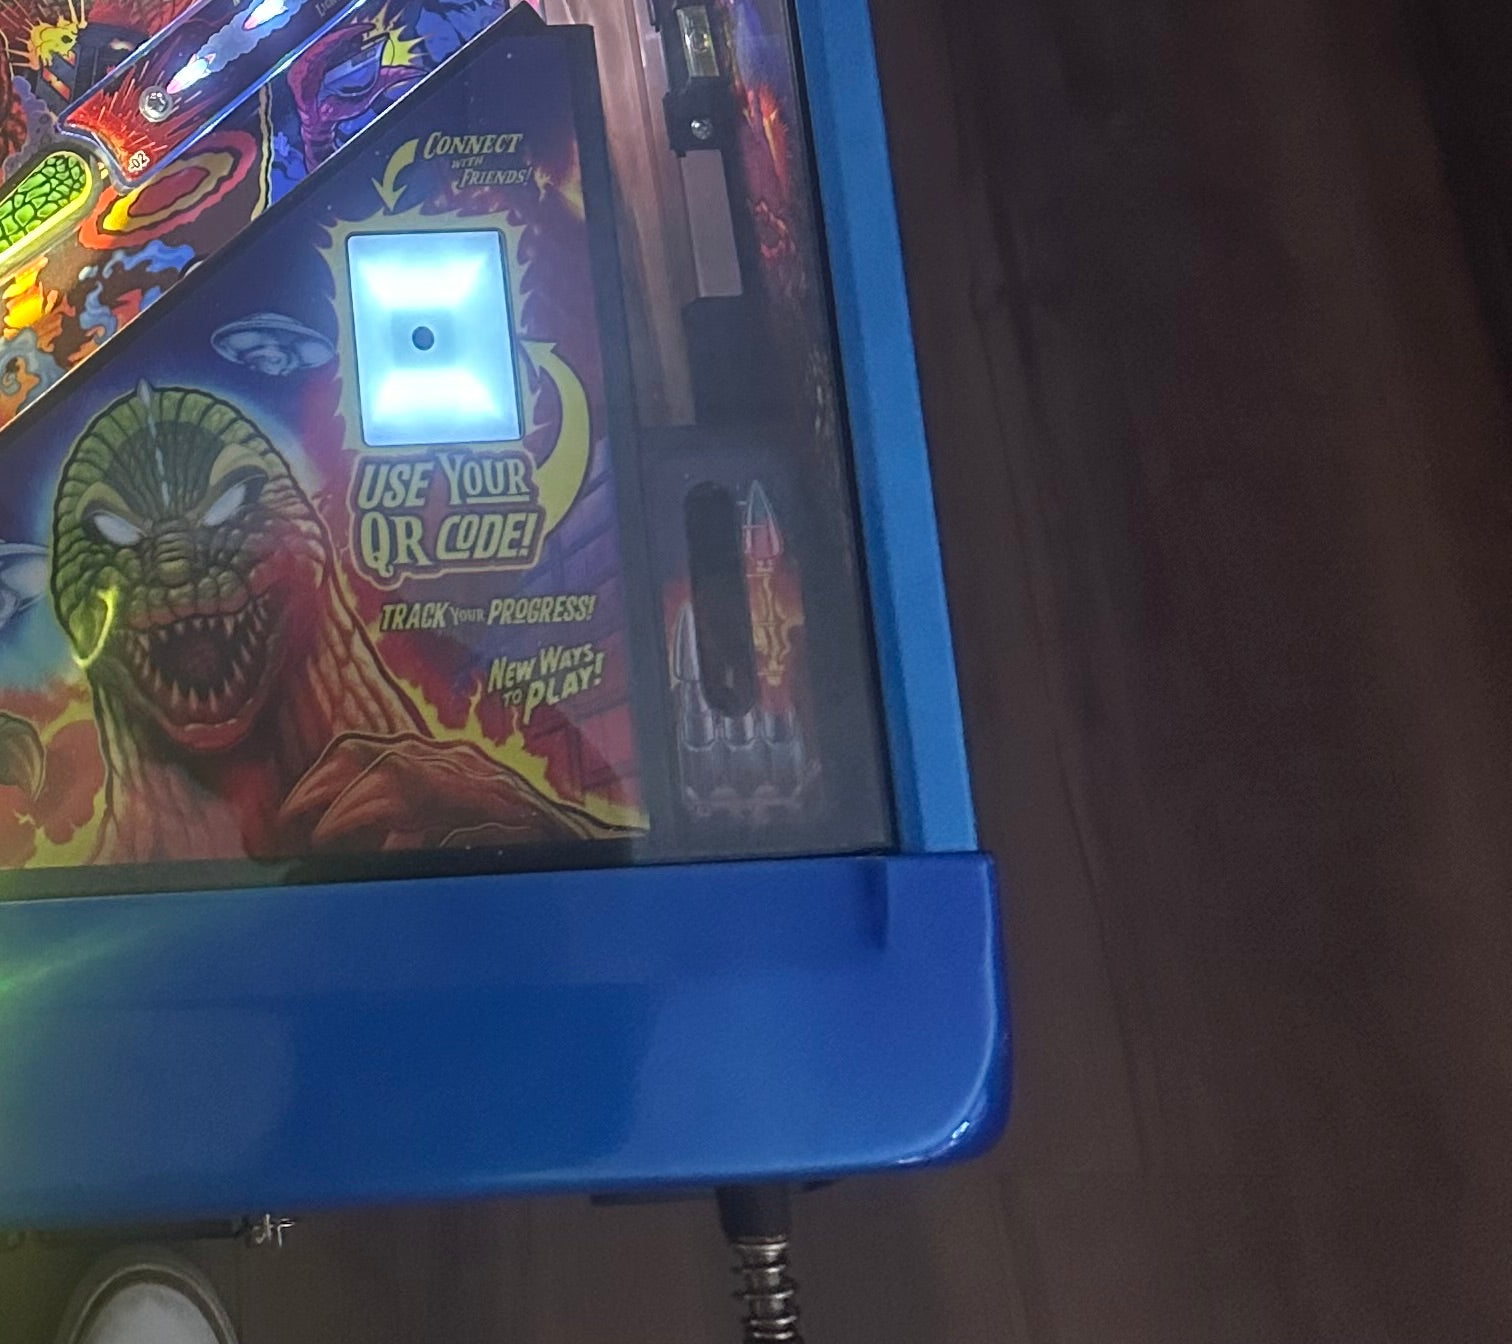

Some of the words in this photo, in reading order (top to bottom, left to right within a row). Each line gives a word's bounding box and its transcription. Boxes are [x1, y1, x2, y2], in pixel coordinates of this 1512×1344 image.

[423, 132, 523, 159] CONNECT
[451, 155, 485, 170] WITH
[458, 166, 533, 190] FRIENDS!
[357, 460, 433, 511] USE
[442, 452, 533, 506] YOUR
[359, 514, 430, 577] QR
[434, 513, 535, 563] CODE!
[380, 602, 448, 631] TRACK
[450, 606, 486, 626] YOUR
[487, 595, 597, 625] PROGRESS!
[489, 654, 535, 693] NEW
[538, 644, 594, 680] WAYS
[502, 689, 524, 708] TO
[523, 655, 605, 725] PLAY!
